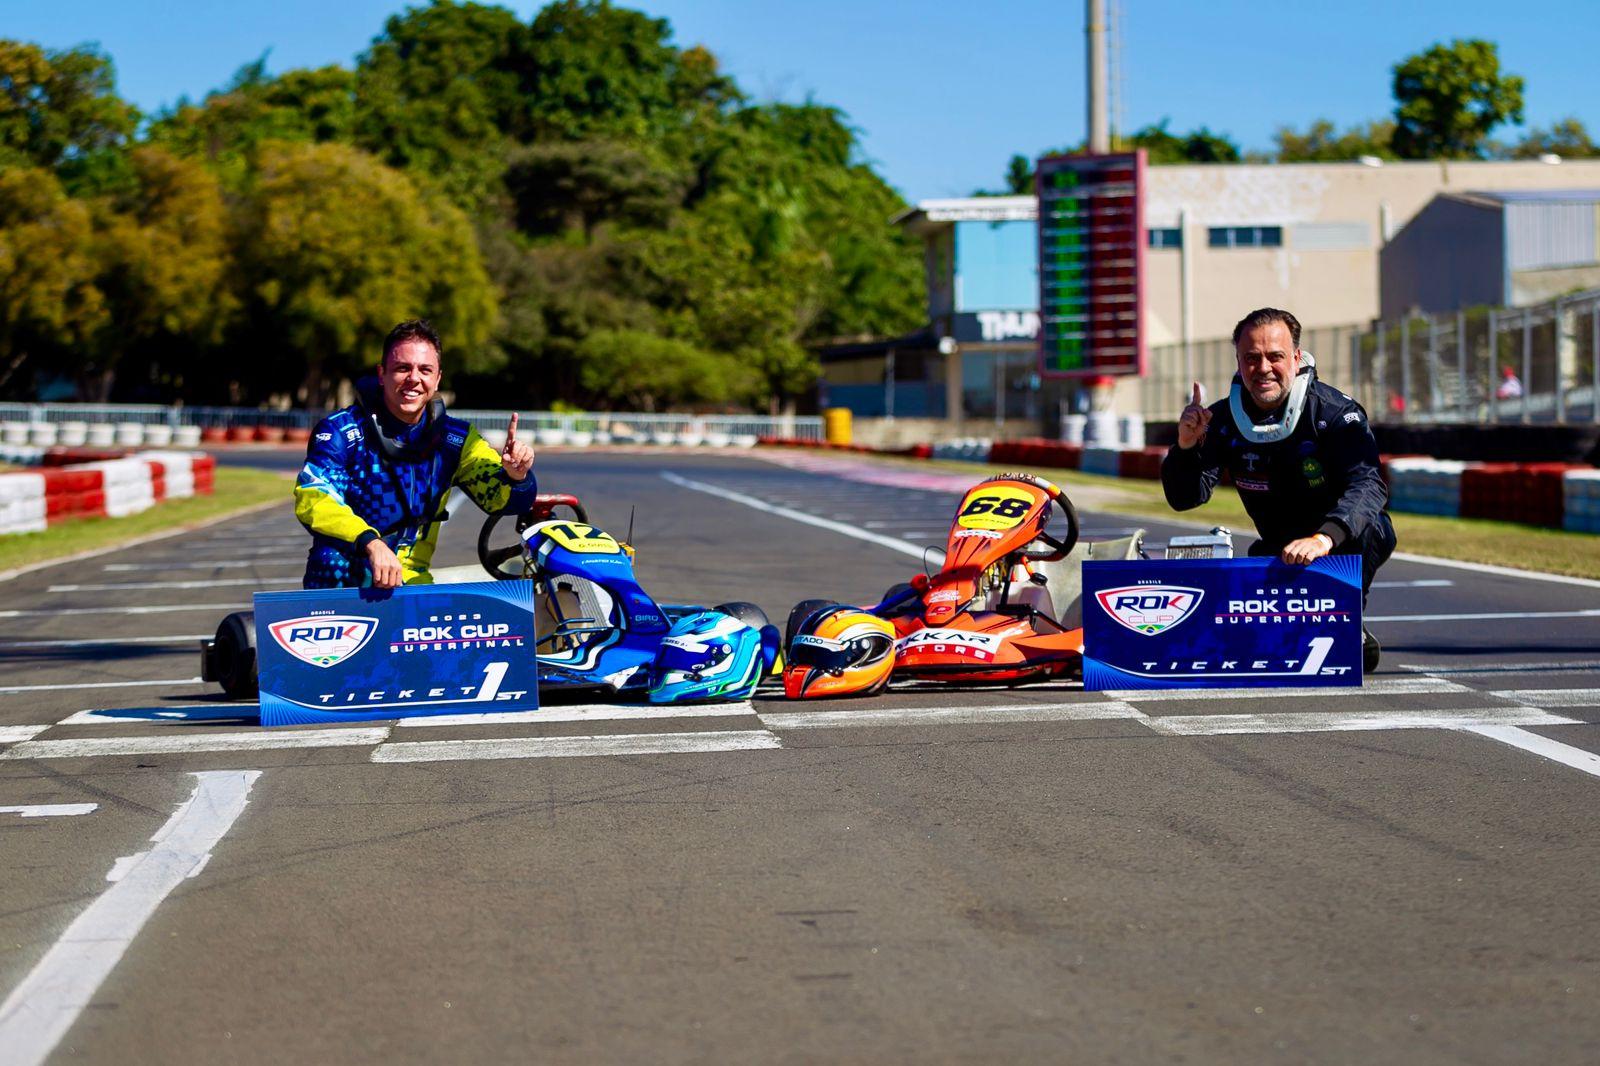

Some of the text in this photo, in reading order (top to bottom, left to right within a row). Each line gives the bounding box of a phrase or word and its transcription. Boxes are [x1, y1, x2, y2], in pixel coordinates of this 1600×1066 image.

[961, 496, 1033, 518] 68
[550, 524, 612, 541] 12
[1114, 595, 1186, 615] ROK
[1228, 598, 1336, 613] ROK CUP
[429, 613, 482, 622] 2023
[1128, 615, 1175, 624] CUP
[1214, 615, 1351, 624] SUPERFINAL
[289, 624, 361, 646] ROK
[402, 623, 509, 642] ROK CUP
[303, 645, 350, 656] CUP
[389, 638, 524, 654] SUPERFINAL
[1142, 659, 1300, 671] TICKET
[319, 686, 477, 703] TICKET
